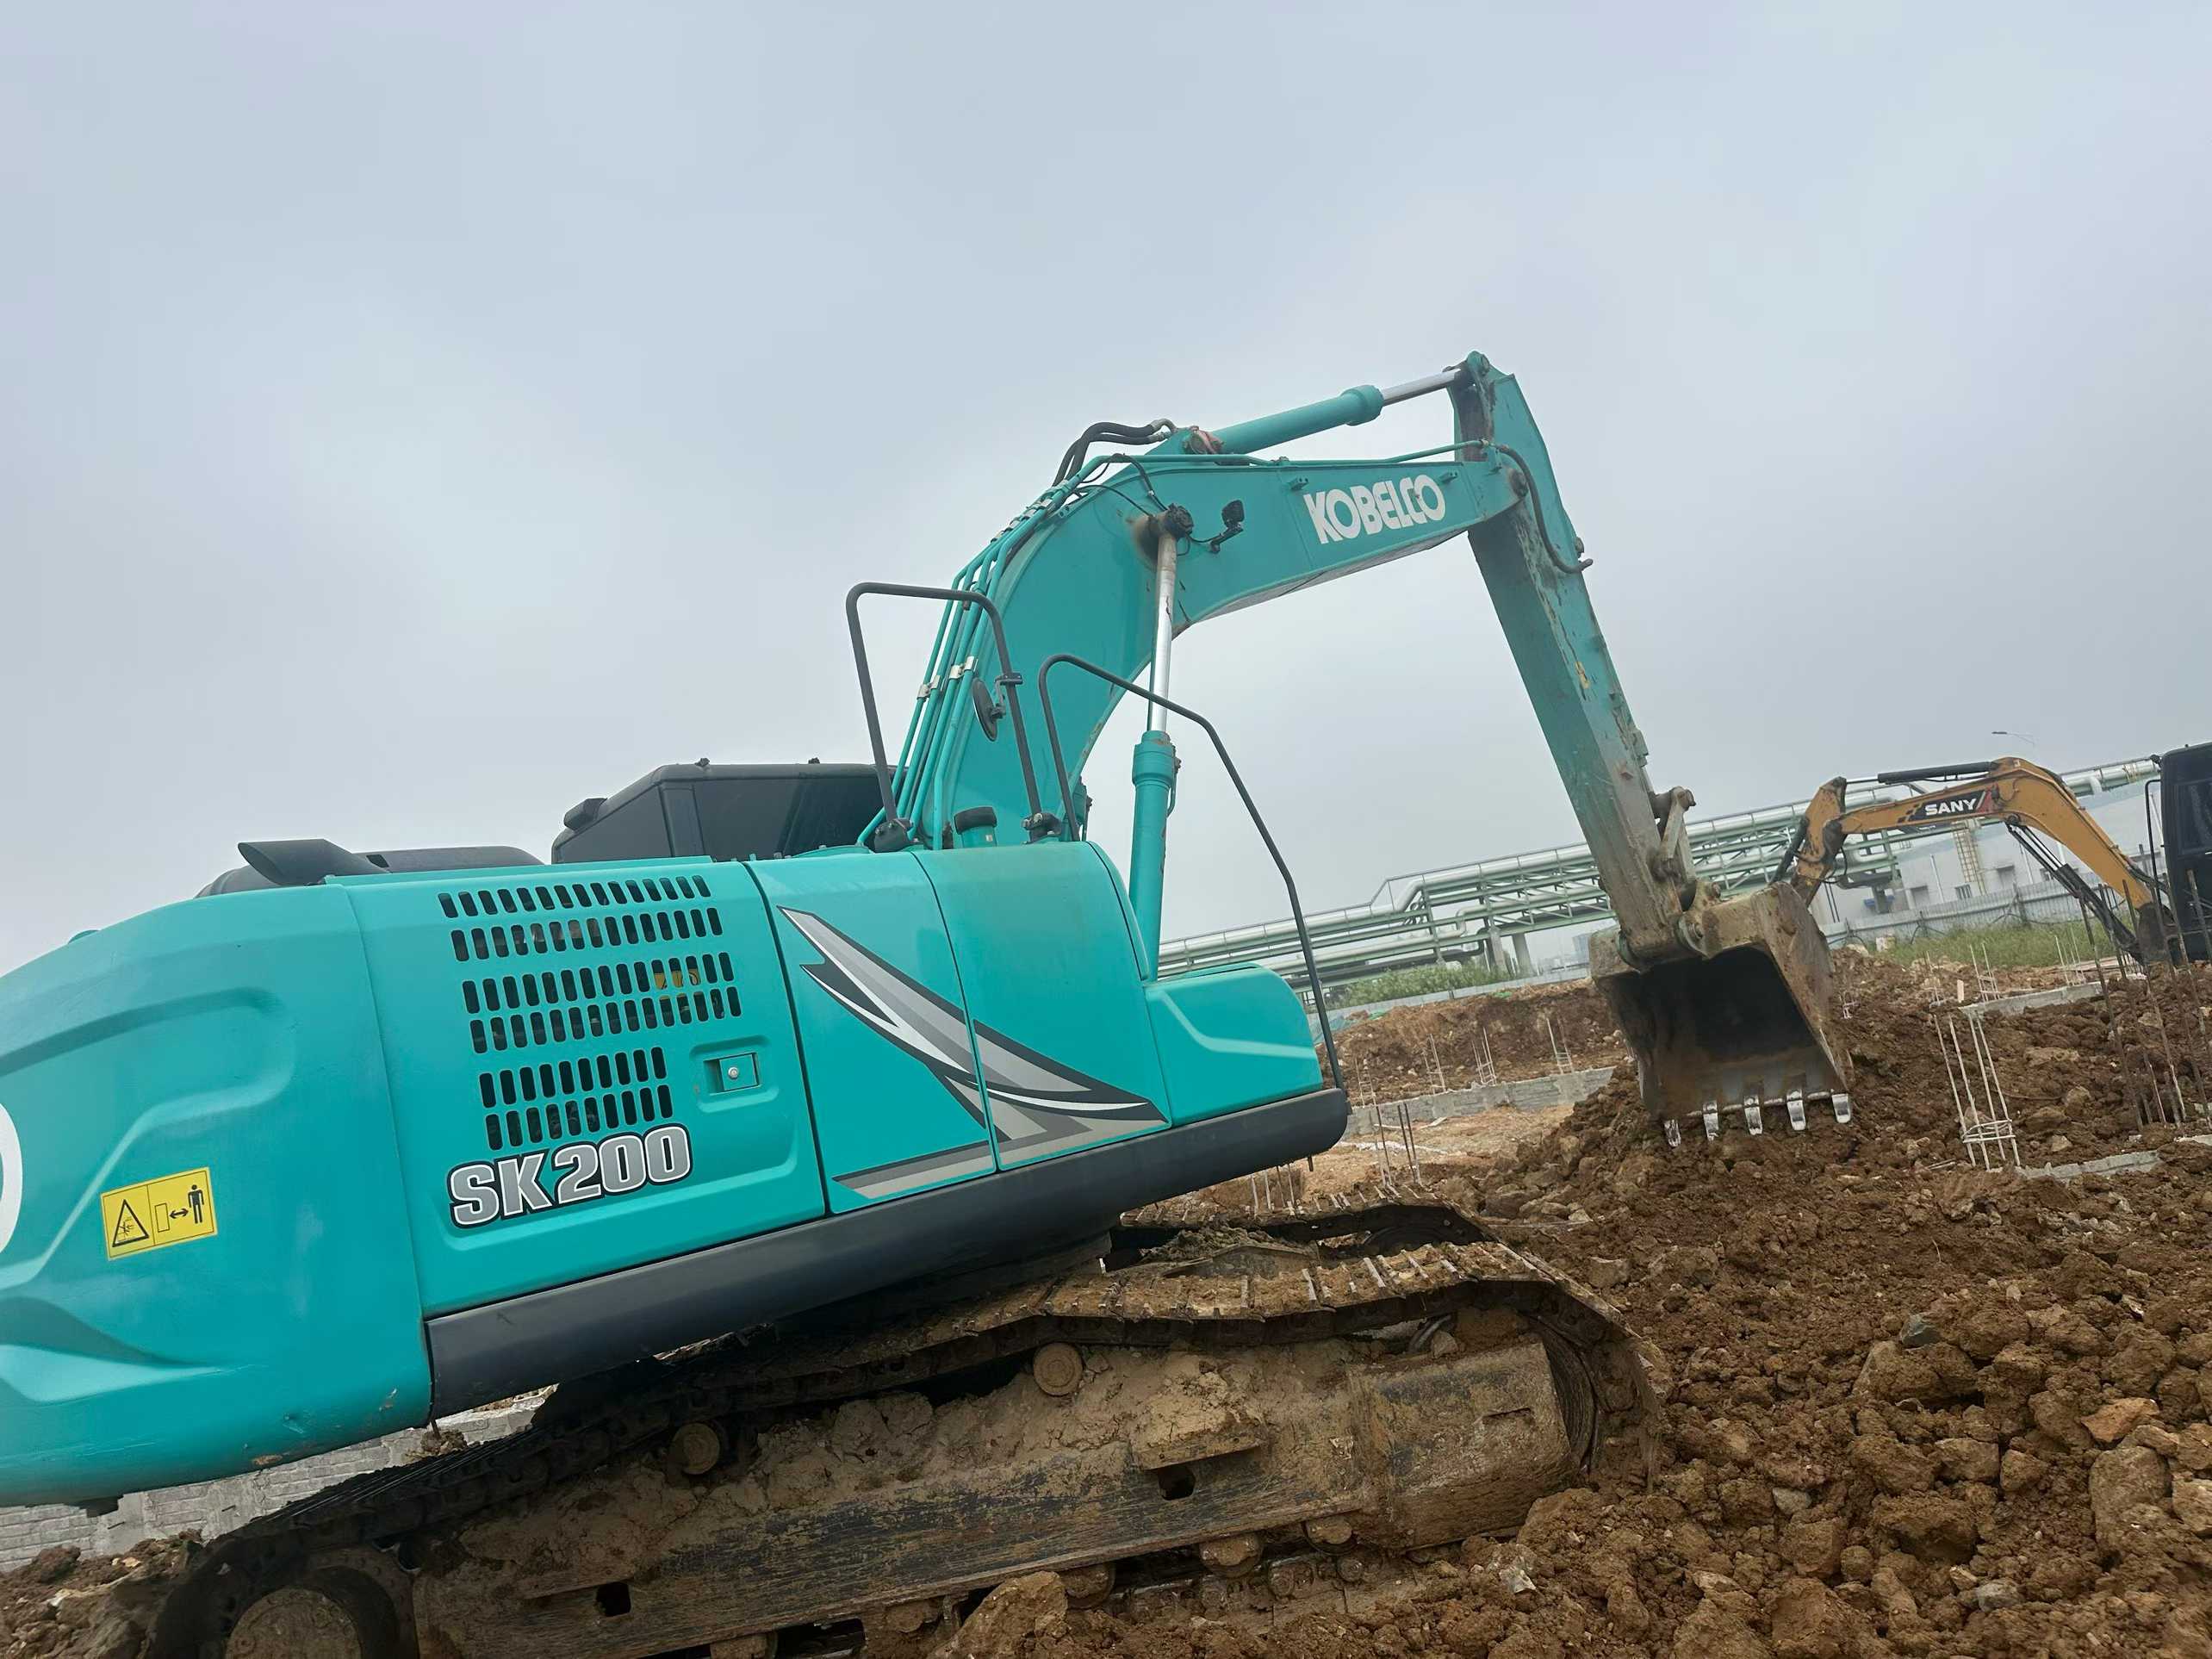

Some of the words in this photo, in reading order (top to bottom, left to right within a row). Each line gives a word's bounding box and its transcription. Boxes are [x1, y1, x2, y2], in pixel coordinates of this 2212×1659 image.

[1303, 475, 1445, 544] KOBELCO
[1925, 798, 1977, 816] SANY
[448, 1123, 693, 1227] SK200
